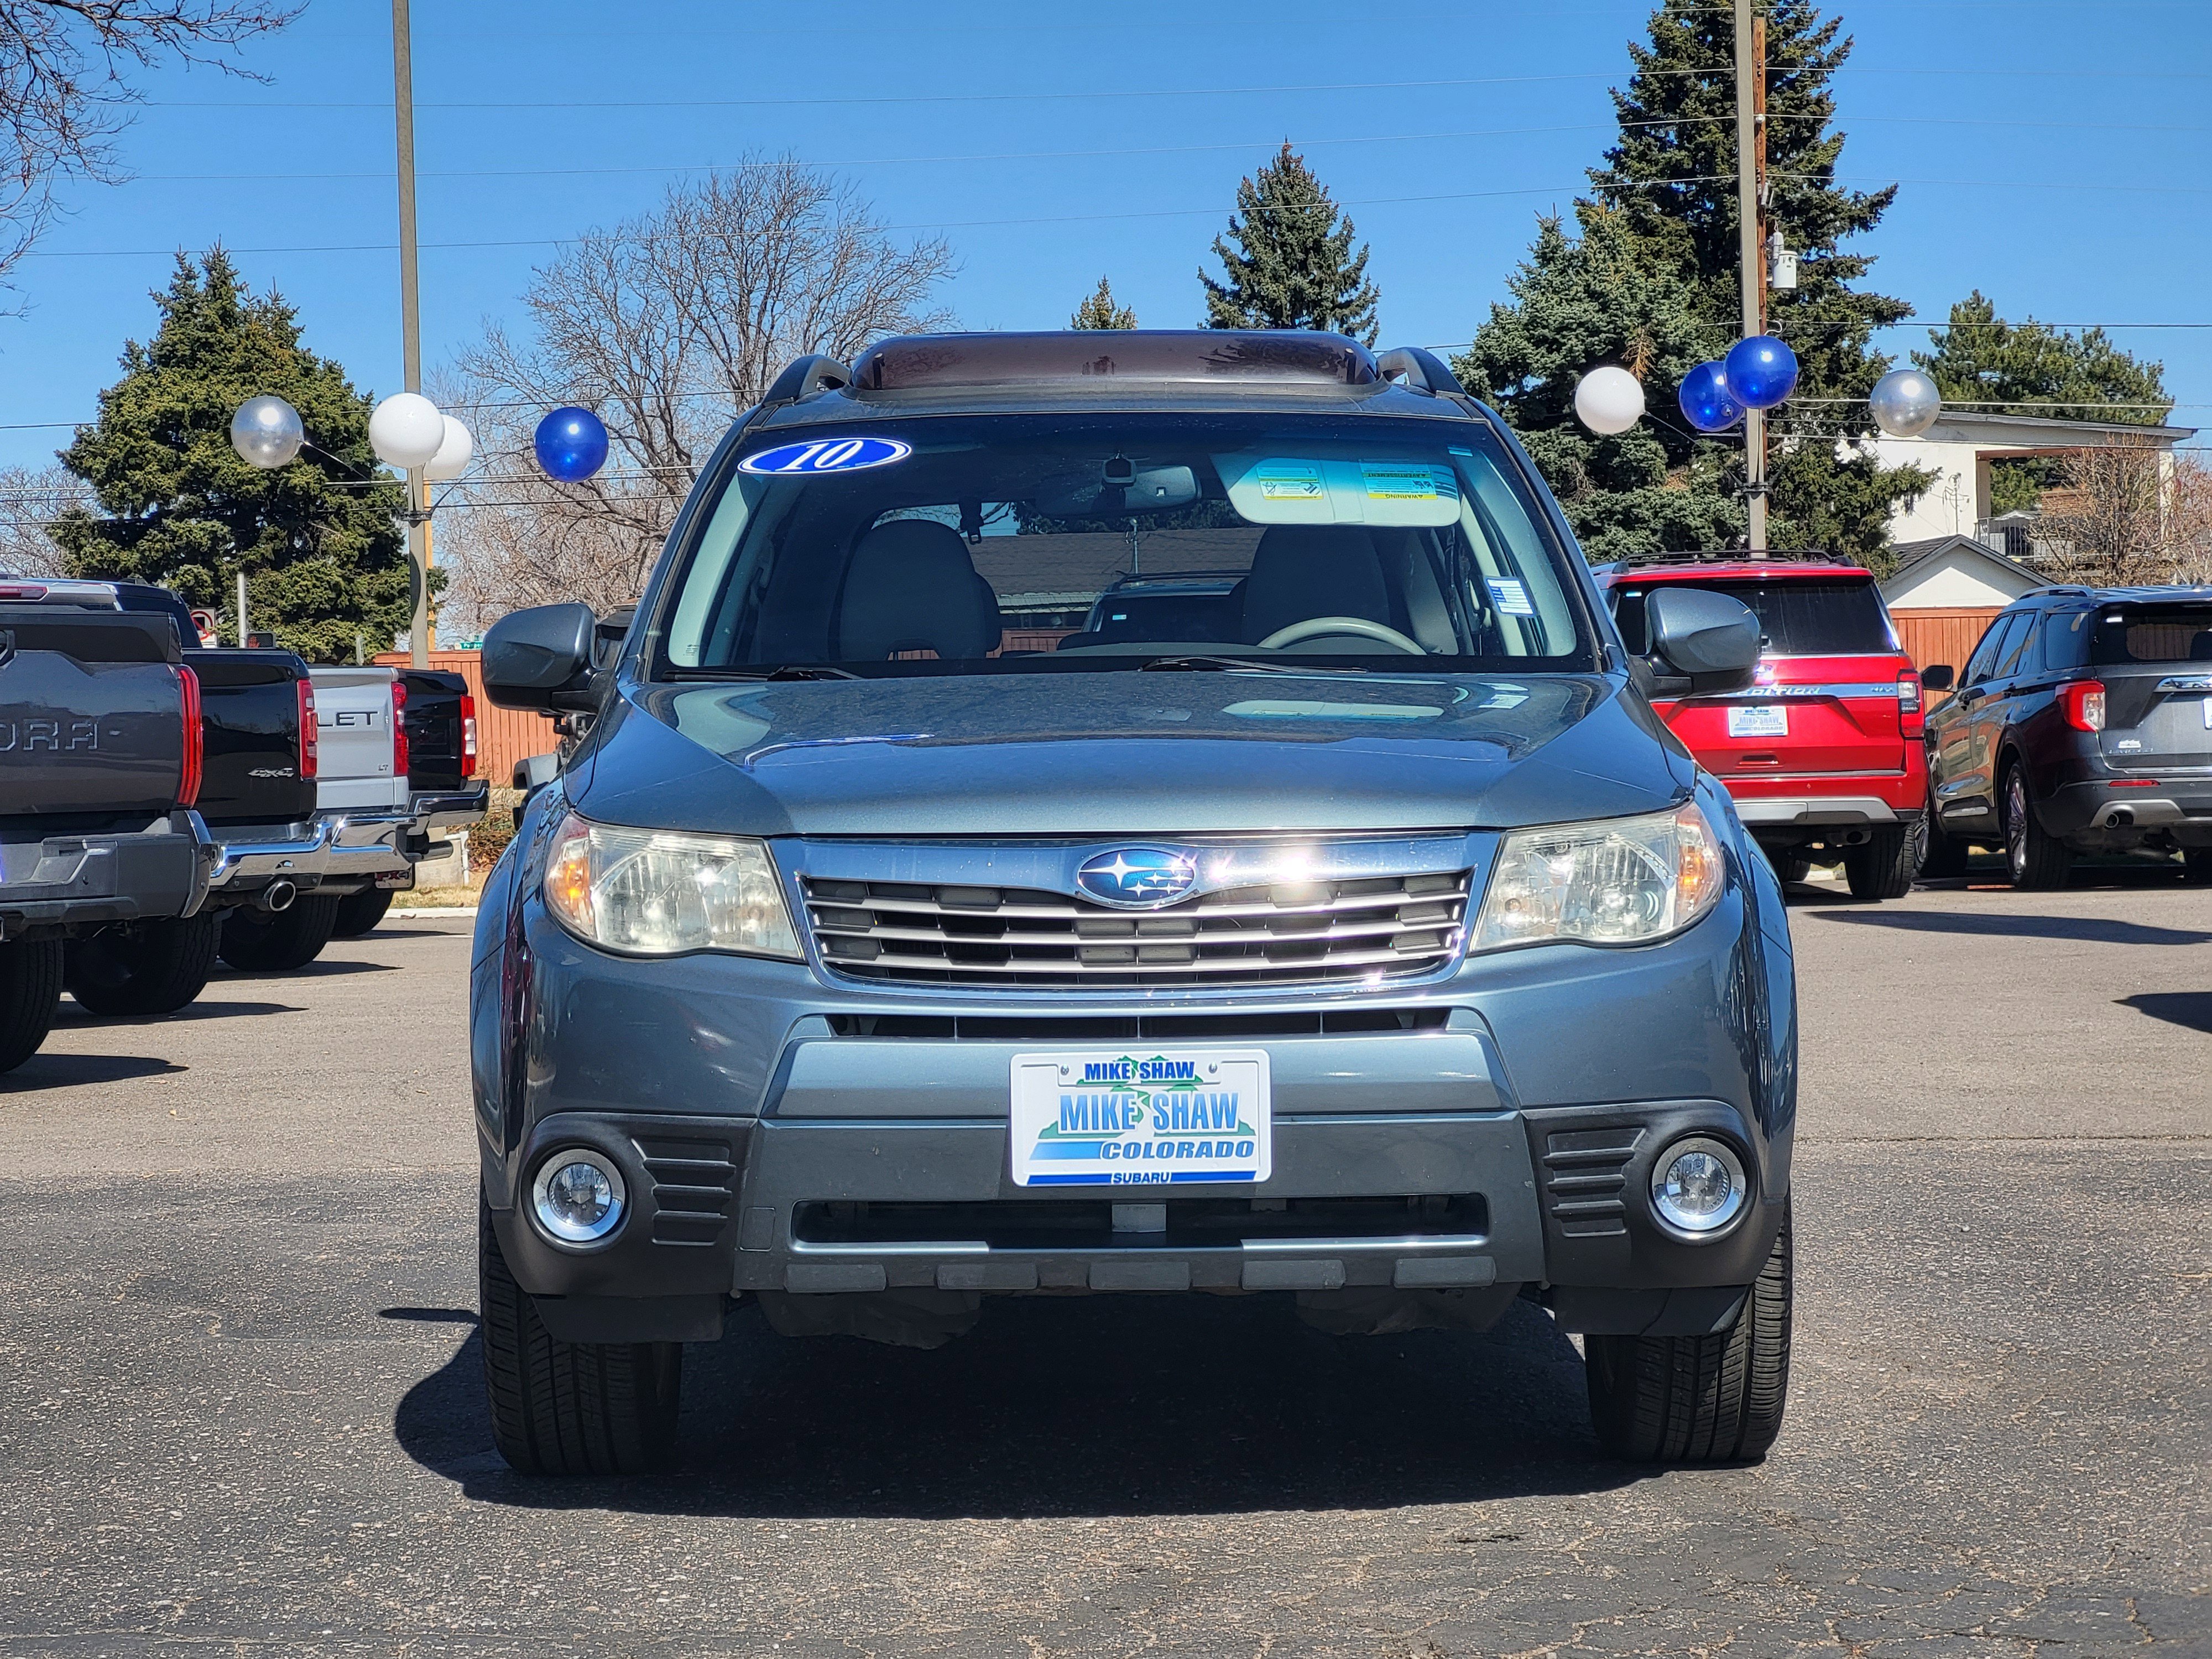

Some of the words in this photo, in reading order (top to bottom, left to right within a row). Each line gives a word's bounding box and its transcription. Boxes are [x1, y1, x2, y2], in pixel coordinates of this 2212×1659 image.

[774, 440, 864, 472] 10
[317, 711, 378, 727] LET
[1739, 716, 1756, 724] MIKE
[1760, 716, 1779, 724] SHAW
[1084, 1061, 1130, 1081] MIKE
[1139, 1061, 1195, 1079] SHAW
[1060, 1094, 1136, 1131] MIKE
[1152, 1092, 1239, 1131] SHAW
[1103, 1140, 1255, 1160] COLORADO
[1112, 1172, 1170, 1184] SUBARU
